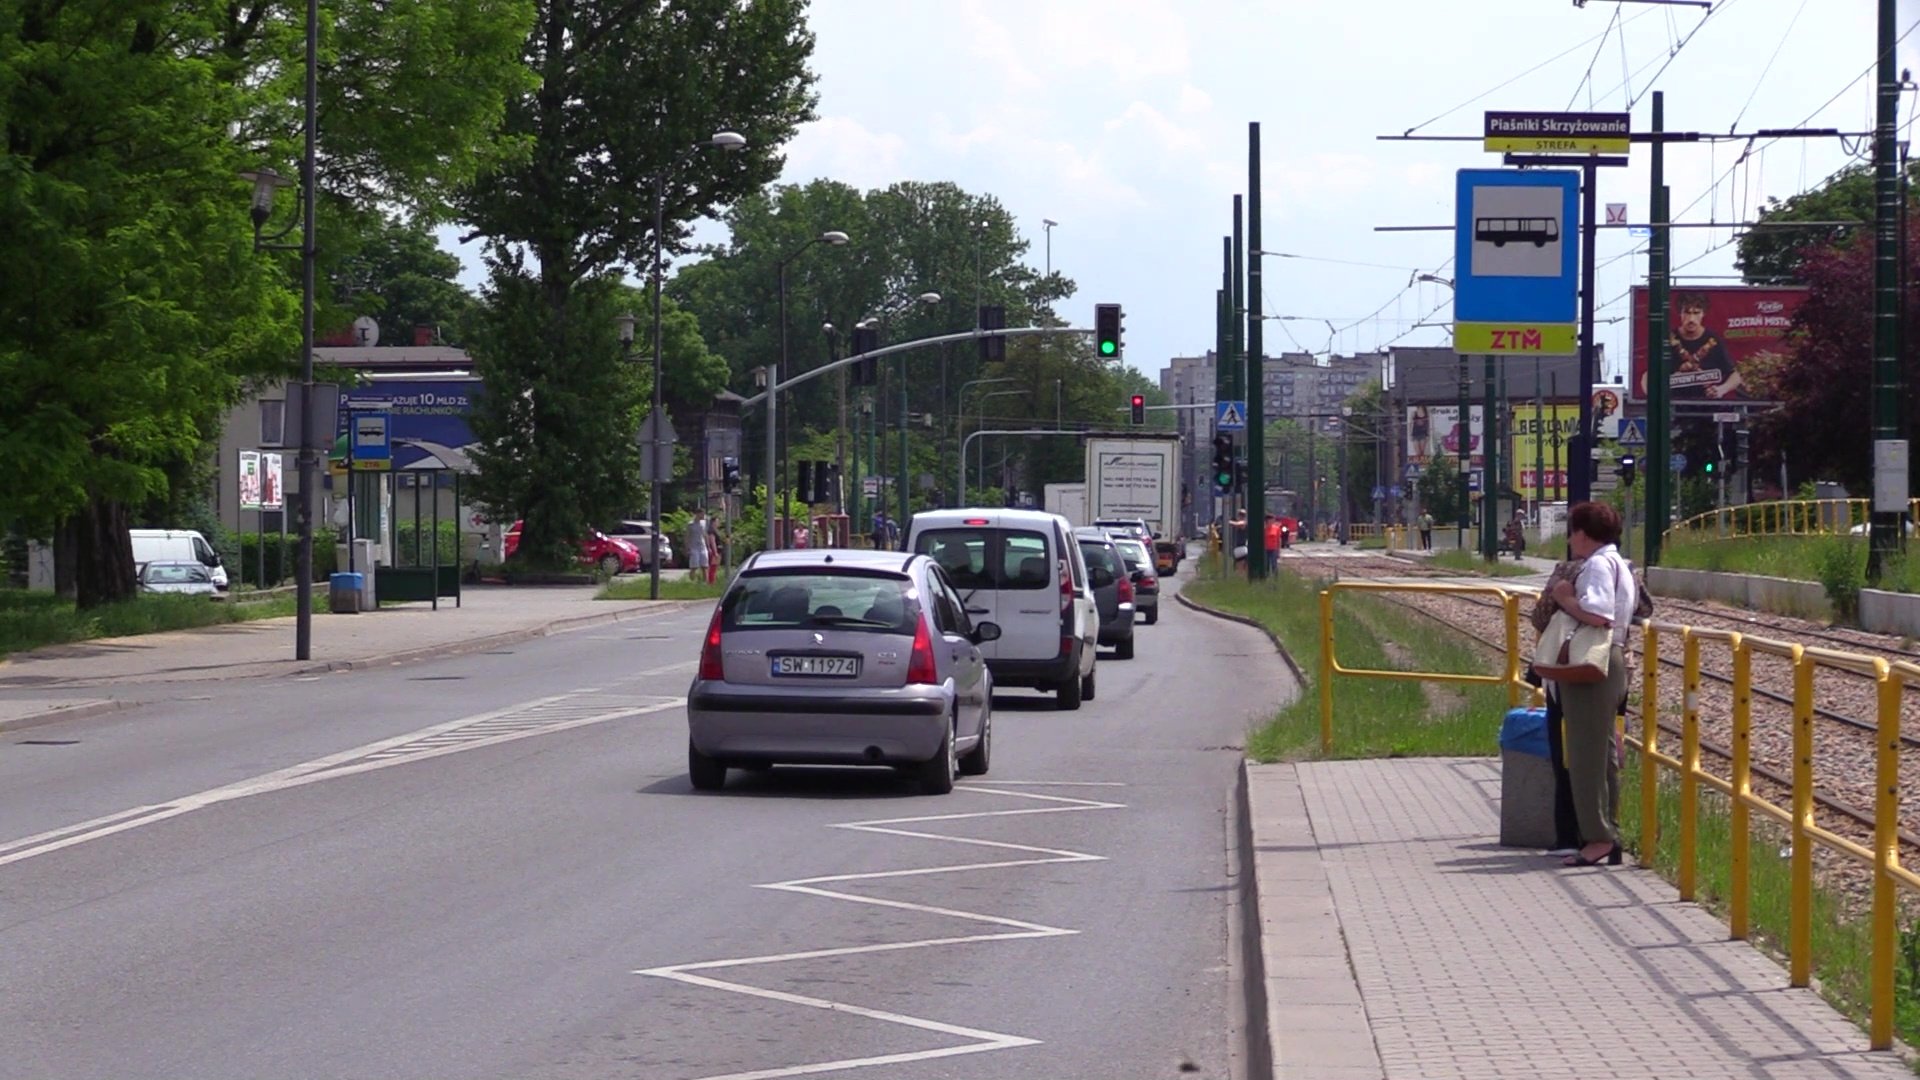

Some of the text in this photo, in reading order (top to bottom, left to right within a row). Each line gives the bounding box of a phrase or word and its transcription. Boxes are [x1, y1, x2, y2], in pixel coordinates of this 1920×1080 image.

[1490, 118, 1627, 134] Piaśniki Skrzyżowanie
[1536, 140, 1577, 150] STREFA
[1727, 314, 1763, 328] ZOSTAŃ
[1490, 328, 1542, 350] ZTM
[420, 393, 435, 404] 10
[782, 658, 805, 672] SW
[809, 657, 855, 674] 11974
